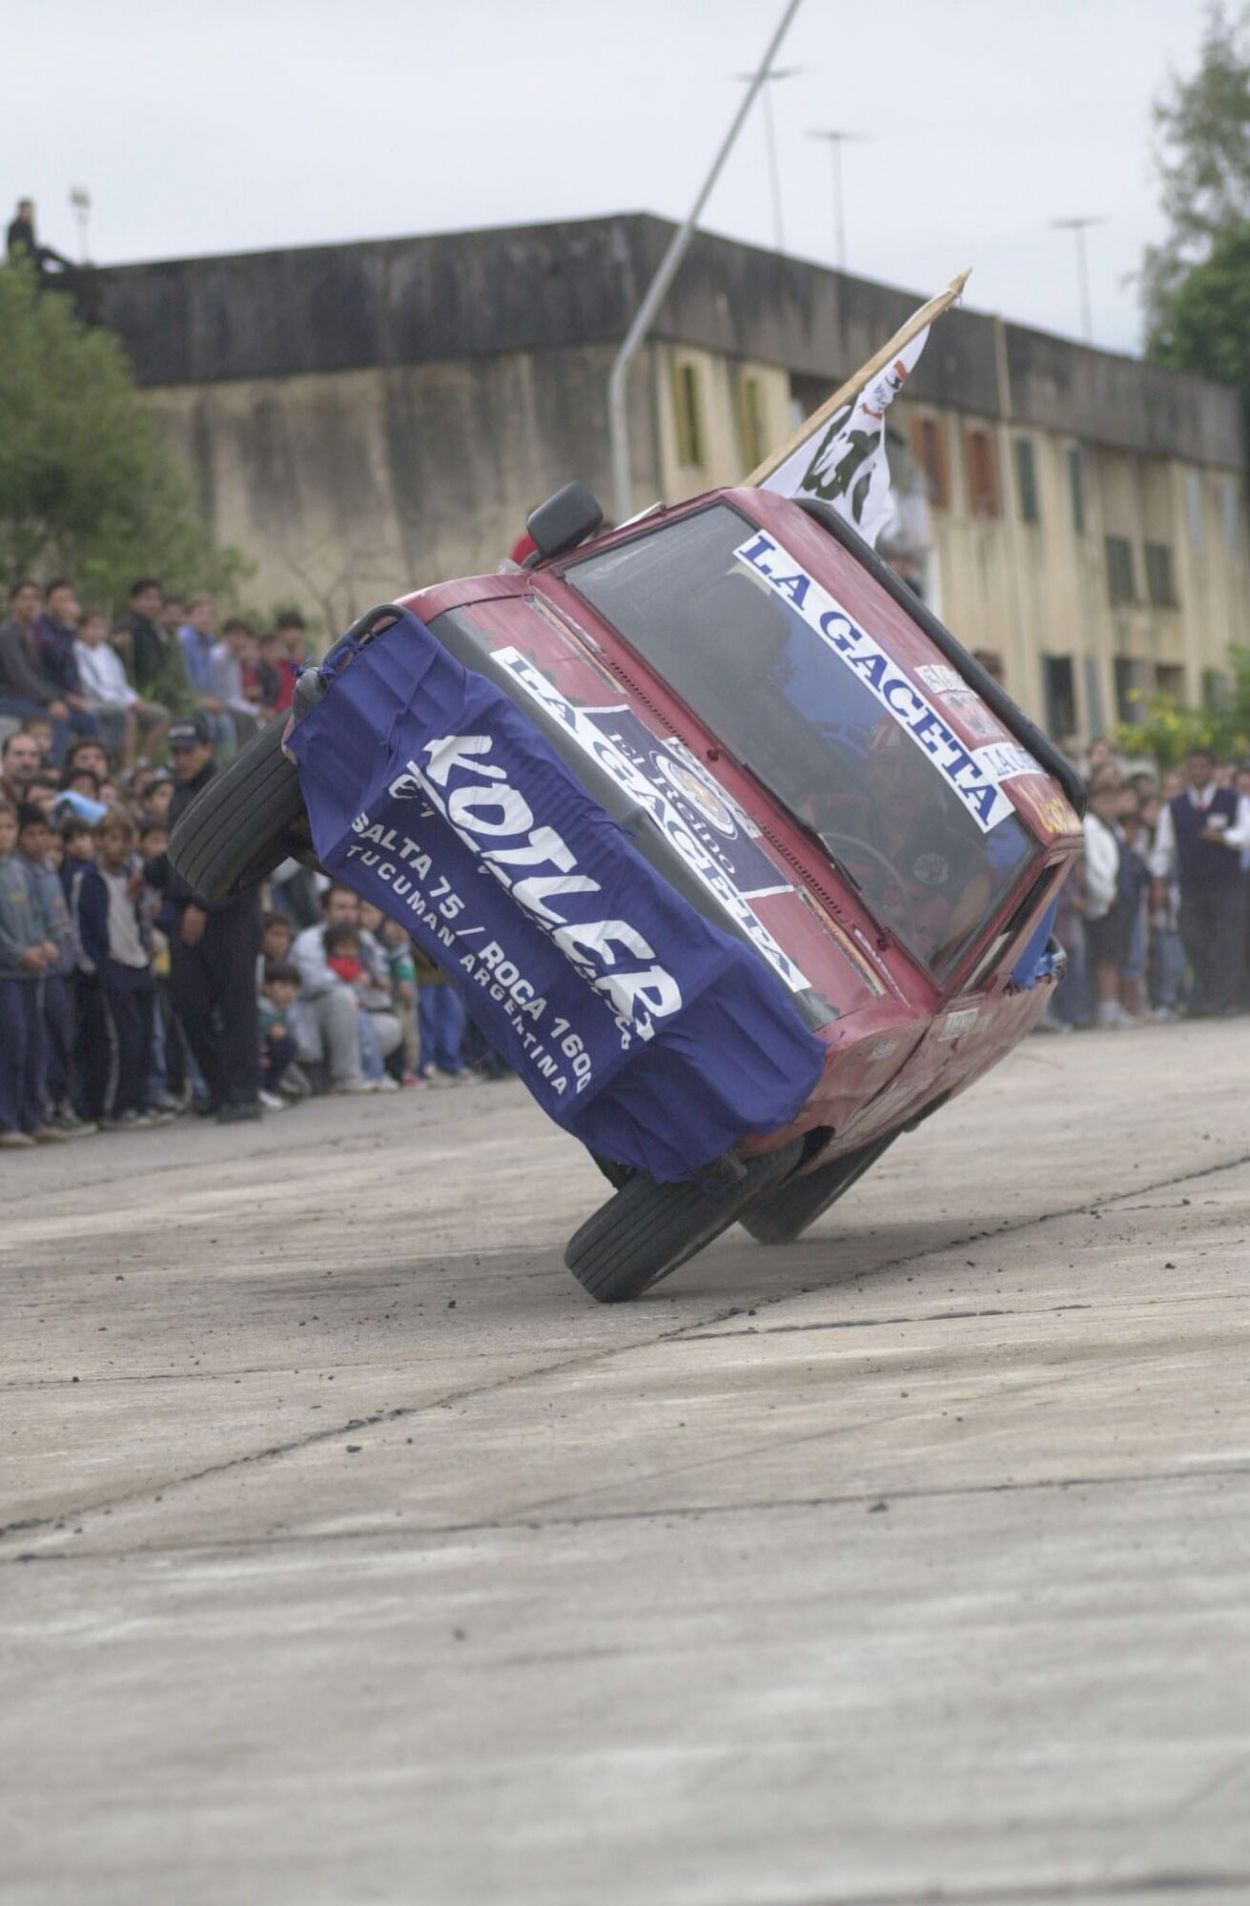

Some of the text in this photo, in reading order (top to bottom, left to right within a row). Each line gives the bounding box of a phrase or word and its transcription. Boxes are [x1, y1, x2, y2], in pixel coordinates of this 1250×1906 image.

[608, 733, 646, 765] El
[652, 777, 736, 874] Reino
[740, 535, 814, 611] LA
[819, 610, 999, 826] GACETA
[352, 812, 432, 881] SALTA
[429, 875, 465, 920] 75
[456, 926, 486, 937] /
[478, 940, 547, 1022] ROCA
[423, 735, 682, 1042] KOTLER
[505, 656, 579, 734] LA
[592, 741, 796, 983] GACETA
[345, 845, 456, 947] TUCUMAN
[459, 954, 567, 1095] ARGENTINA
